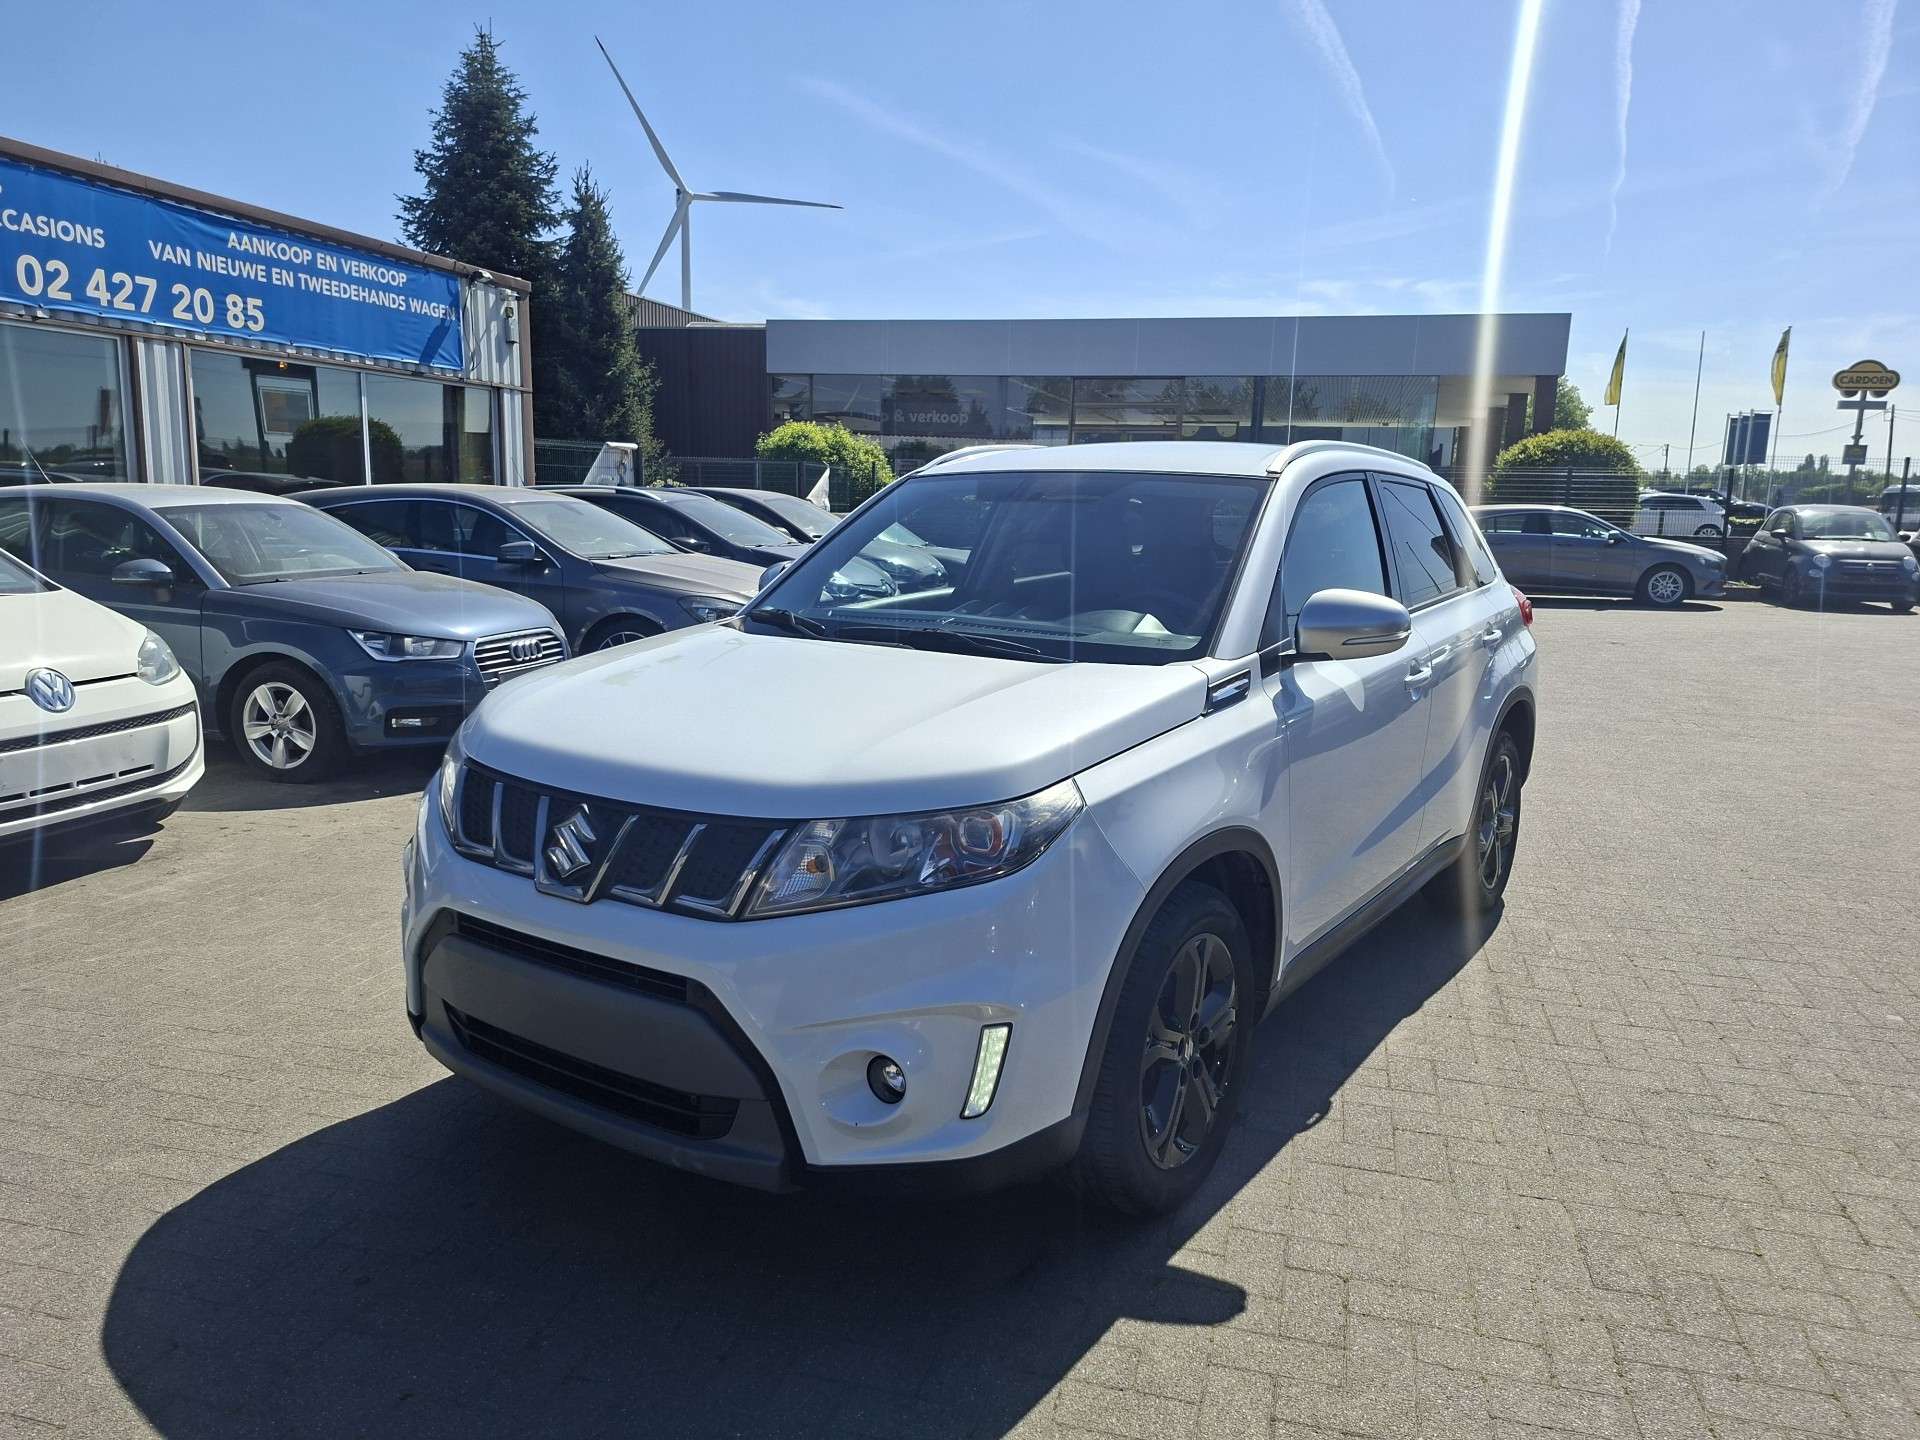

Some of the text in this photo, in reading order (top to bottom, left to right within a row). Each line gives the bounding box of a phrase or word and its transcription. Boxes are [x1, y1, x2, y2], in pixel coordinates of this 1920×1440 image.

[0, 209, 106, 249] CASIONS
[148, 239, 192, 267] VAN
[196, 251, 267, 283] NIEUWE
[271, 267, 295, 288] EN
[298, 273, 407, 311] TWEEDEHANDS
[228, 231, 408, 288] AANKOOP EN VERKOOP
[16, 254, 265, 332] 02 427 20 85
[1840, 375, 1893, 385] CARDOEN
[909, 410, 969, 426] verkoop
